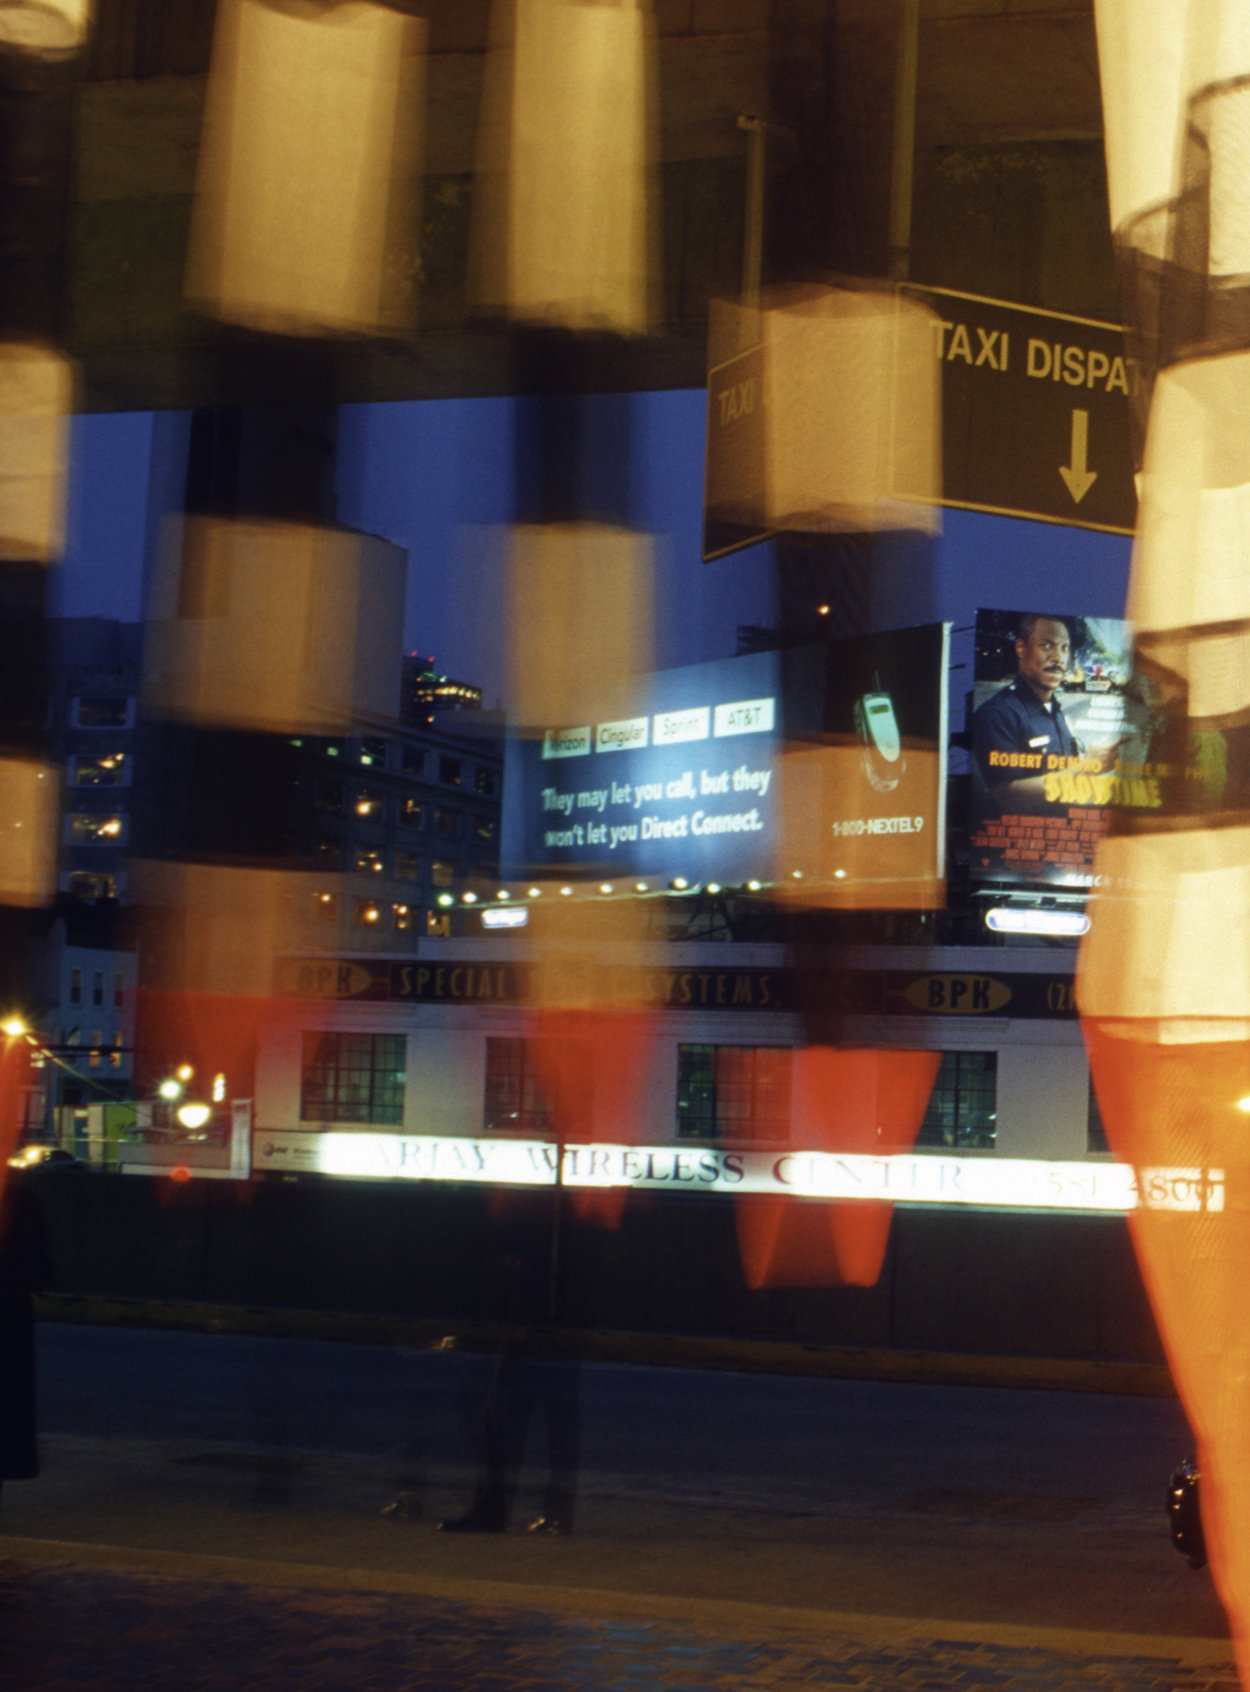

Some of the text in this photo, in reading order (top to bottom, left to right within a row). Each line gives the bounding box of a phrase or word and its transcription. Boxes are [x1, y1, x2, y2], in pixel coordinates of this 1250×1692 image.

[929, 319, 1008, 372] TAXI
[718, 378, 754, 425] TAXI
[600, 725, 645, 747] Cingular
[727, 706, 763, 728] AT&T
[989, 751, 1042, 769] ROBERT
[541, 765, 772, 815] They may let you call, but they
[1044, 772, 1162, 808] SHOWTIME
[545, 809, 763, 849] won't let you Direct Connect.
[300, 965, 353, 994] BPK
[402, 966, 506, 998] SPECIAL
[928, 978, 991, 1009] BPK
[526, 1146, 744, 1184] WIRELESS
